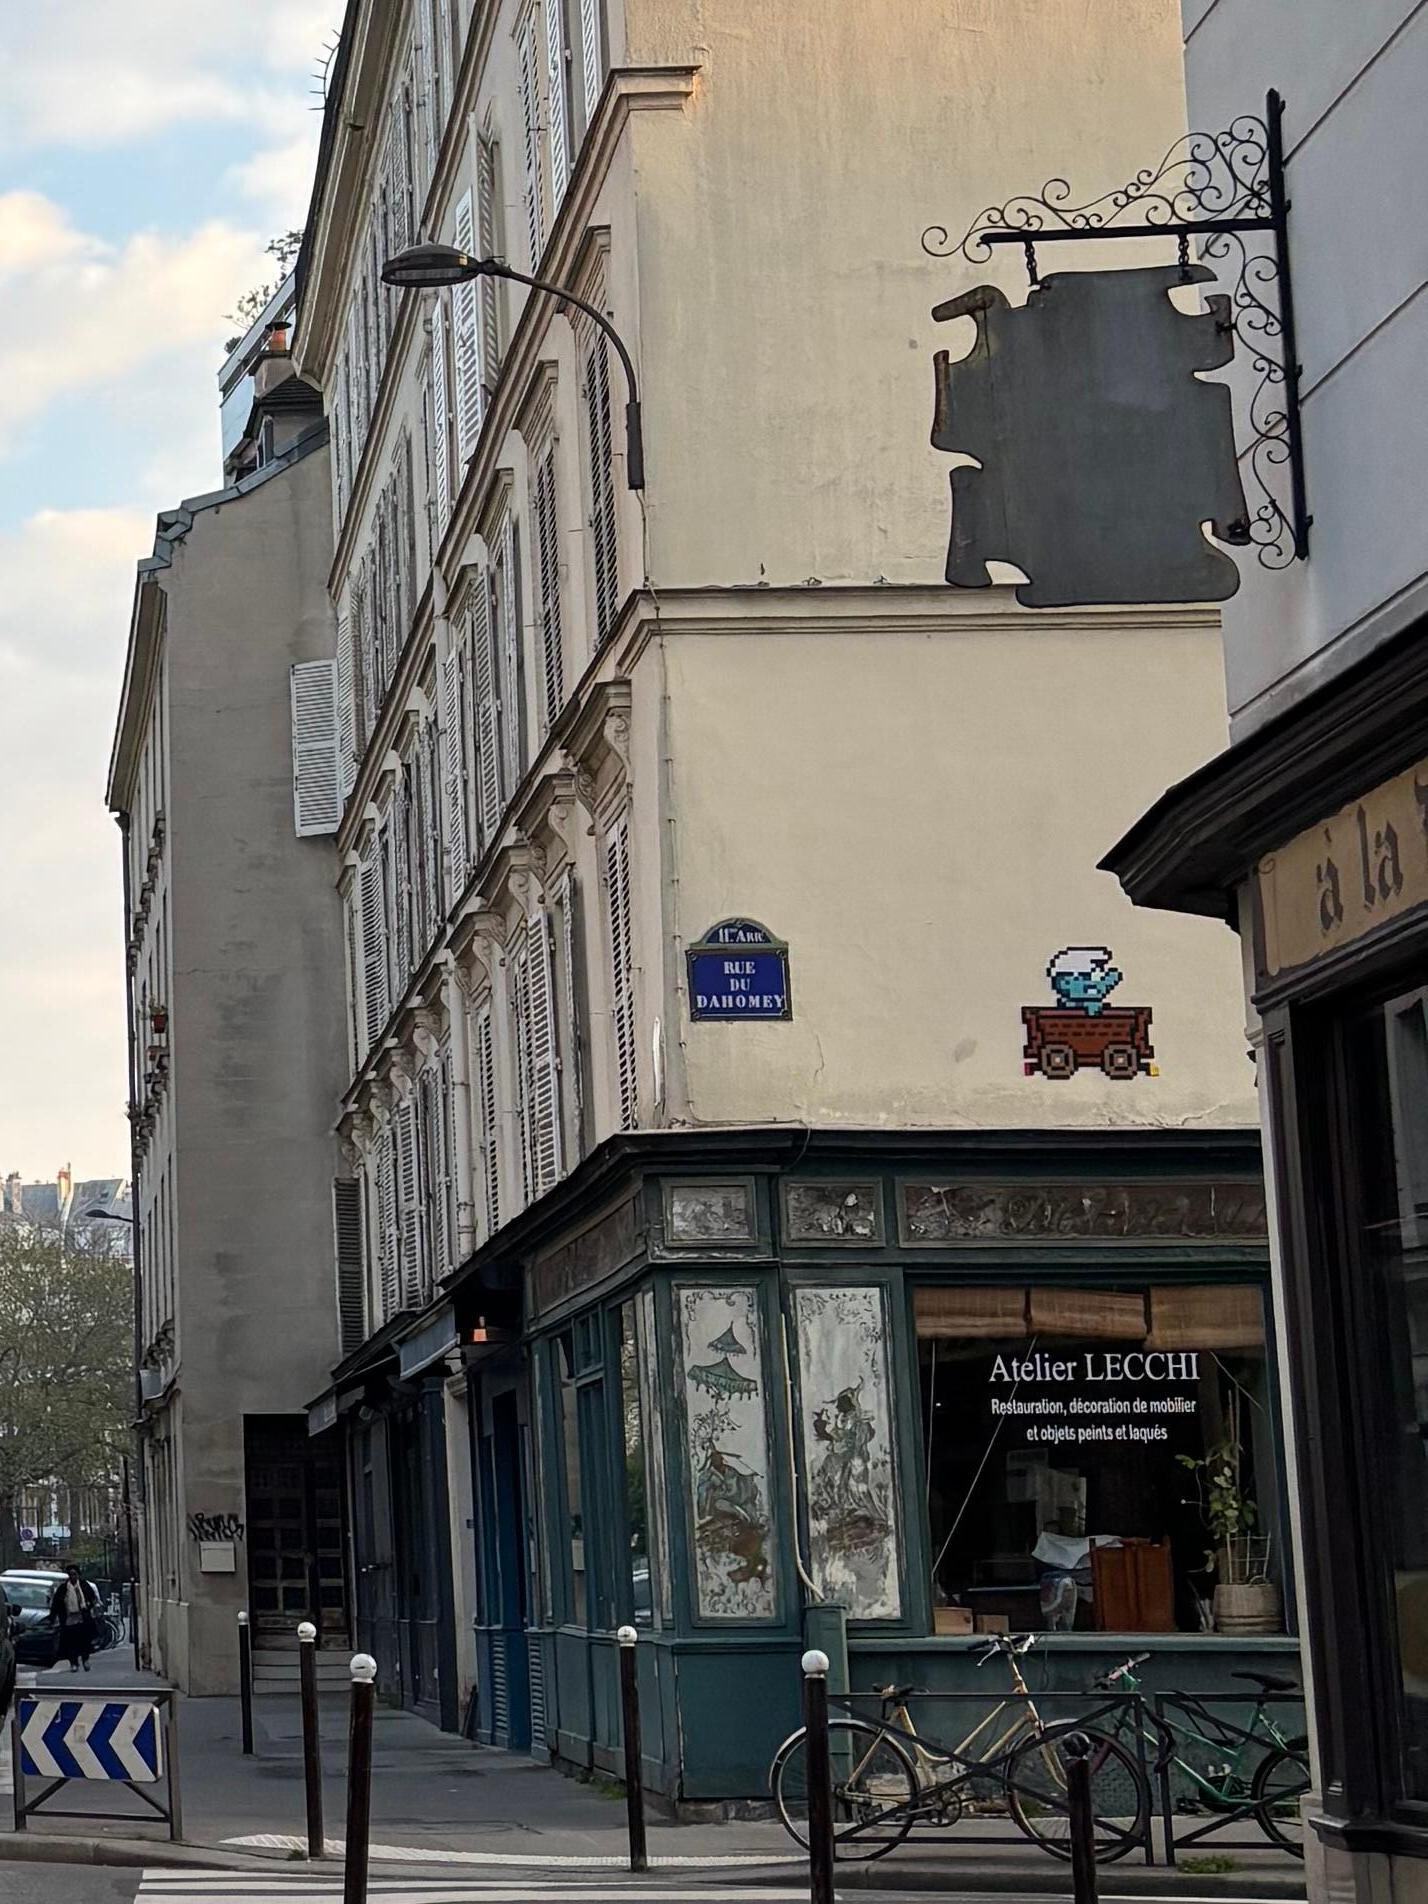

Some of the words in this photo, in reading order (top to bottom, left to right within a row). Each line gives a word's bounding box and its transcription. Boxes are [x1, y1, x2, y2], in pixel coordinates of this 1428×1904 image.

[1356, 803, 1405, 912] la
[723, 961, 756, 975] RUE
[729, 978, 751, 992] DU
[696, 994, 785, 1009] DAHOMEY
[988, 1352, 1078, 1383] Atelier
[1084, 1352, 1201, 1382] LECCHI
[991, 1398, 1067, 1416] Restauration,
[1069, 1397, 1131, 1414] décoration
[1132, 1397, 1148, 1413] de
[1149, 1397, 1197, 1413] mobilier
[1026, 1425, 1039, 1441] et
[1040, 1424, 1076, 1444] objets
[1078, 1424, 1114, 1444] peints
[1115, 1424, 1128, 1440] et
[1129, 1423, 1168, 1444] laqués
